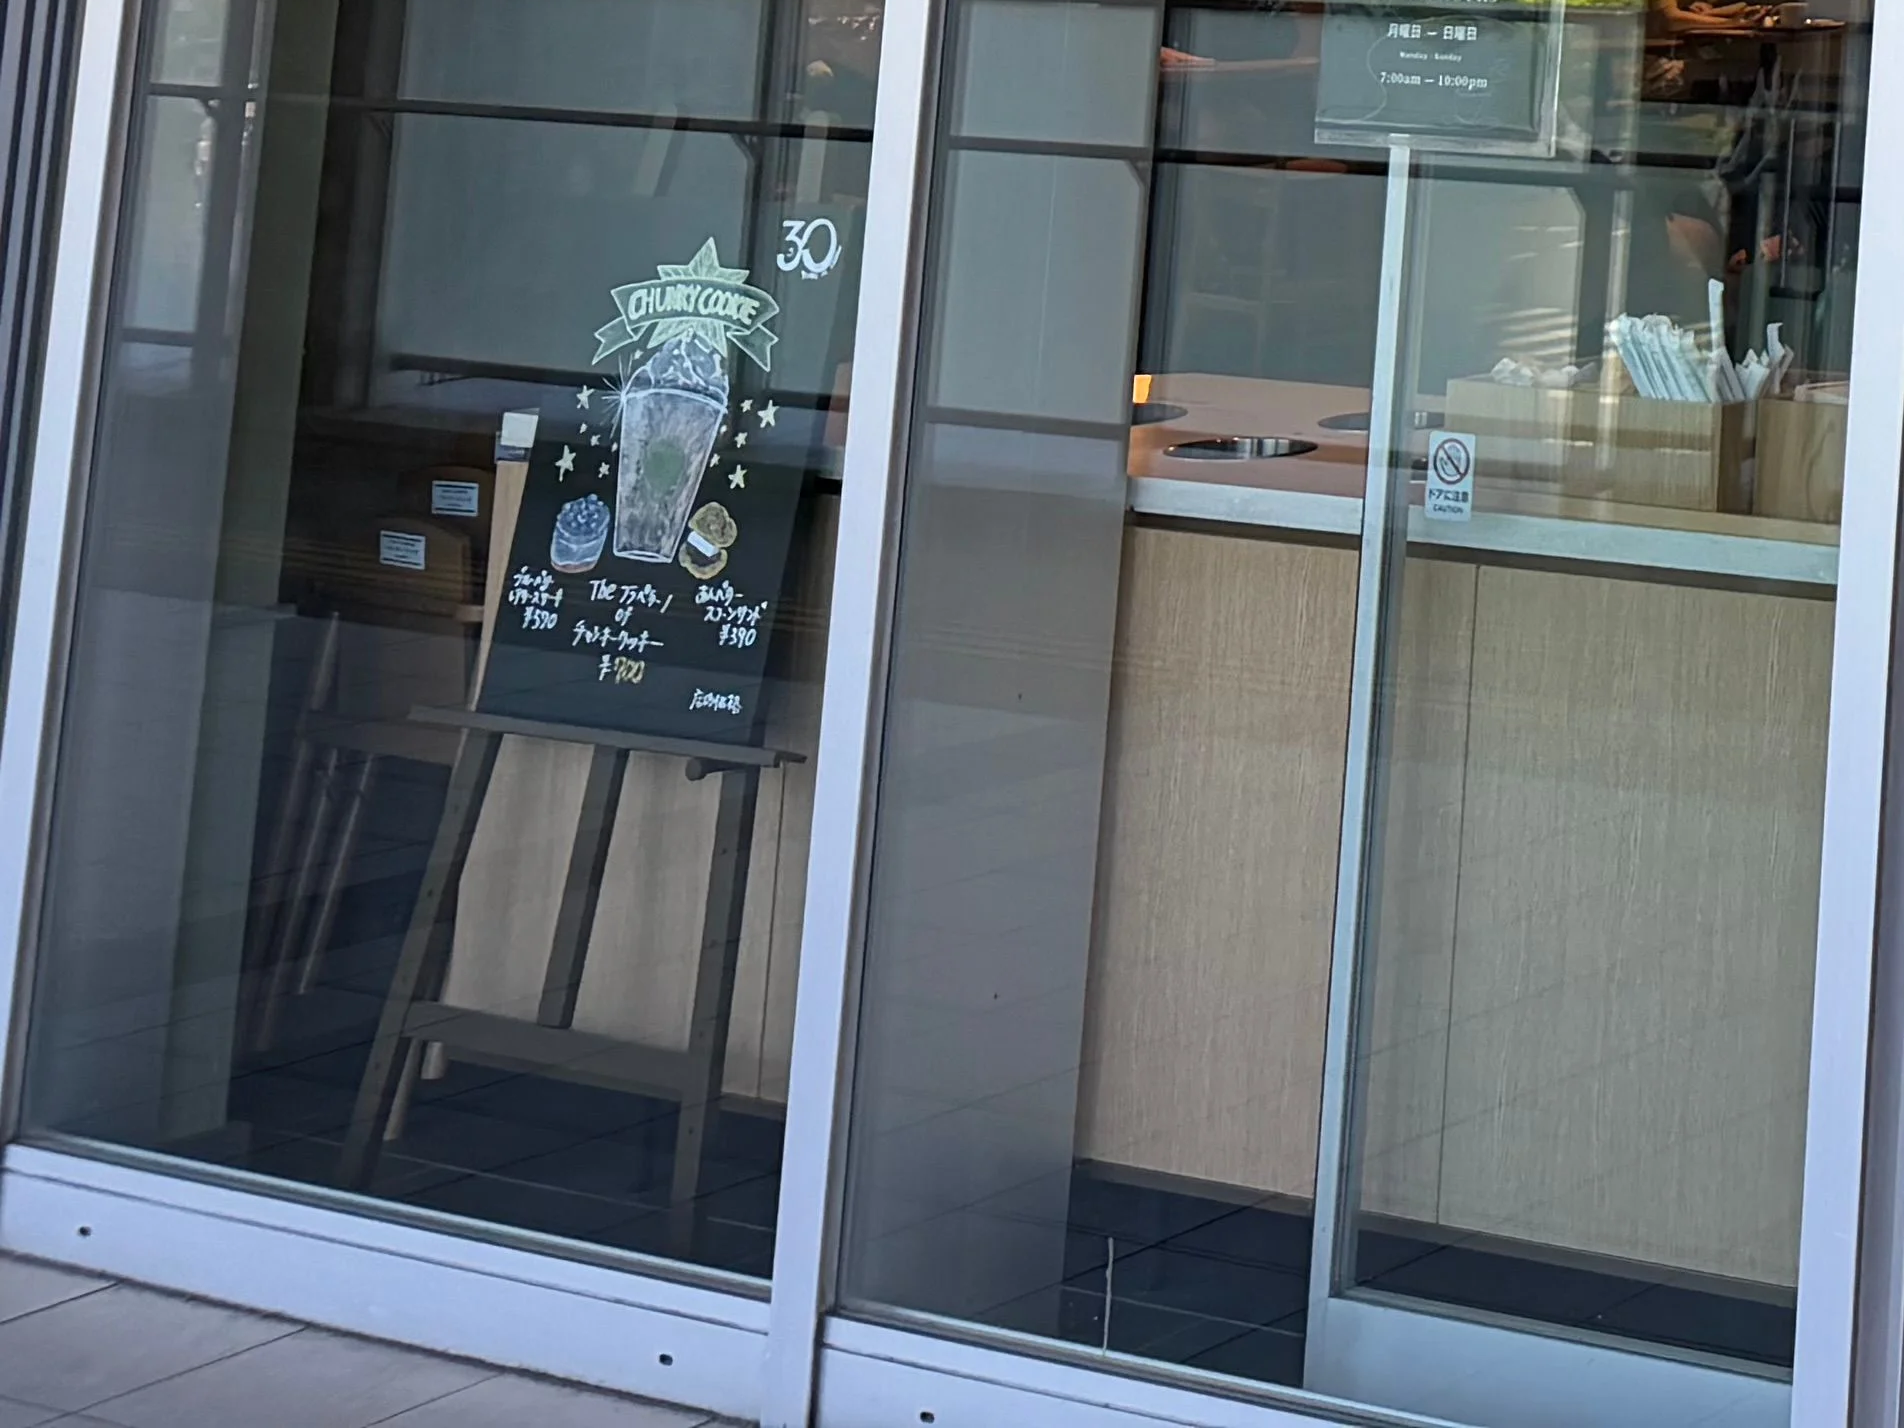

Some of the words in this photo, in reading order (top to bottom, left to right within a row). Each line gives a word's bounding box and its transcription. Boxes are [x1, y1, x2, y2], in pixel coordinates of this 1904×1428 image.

[1387, 23, 1421, 39] 月曜日
[1443, 25, 1477, 41] 日曜日
[1379, 72, 1421, 85] 7:00am
[1438, 74, 1488, 90] 10:00pm
[776, 218, 838, 273] 30
[627, 283, 701, 321] CHUNKY
[697, 286, 760, 325] COOKIE
